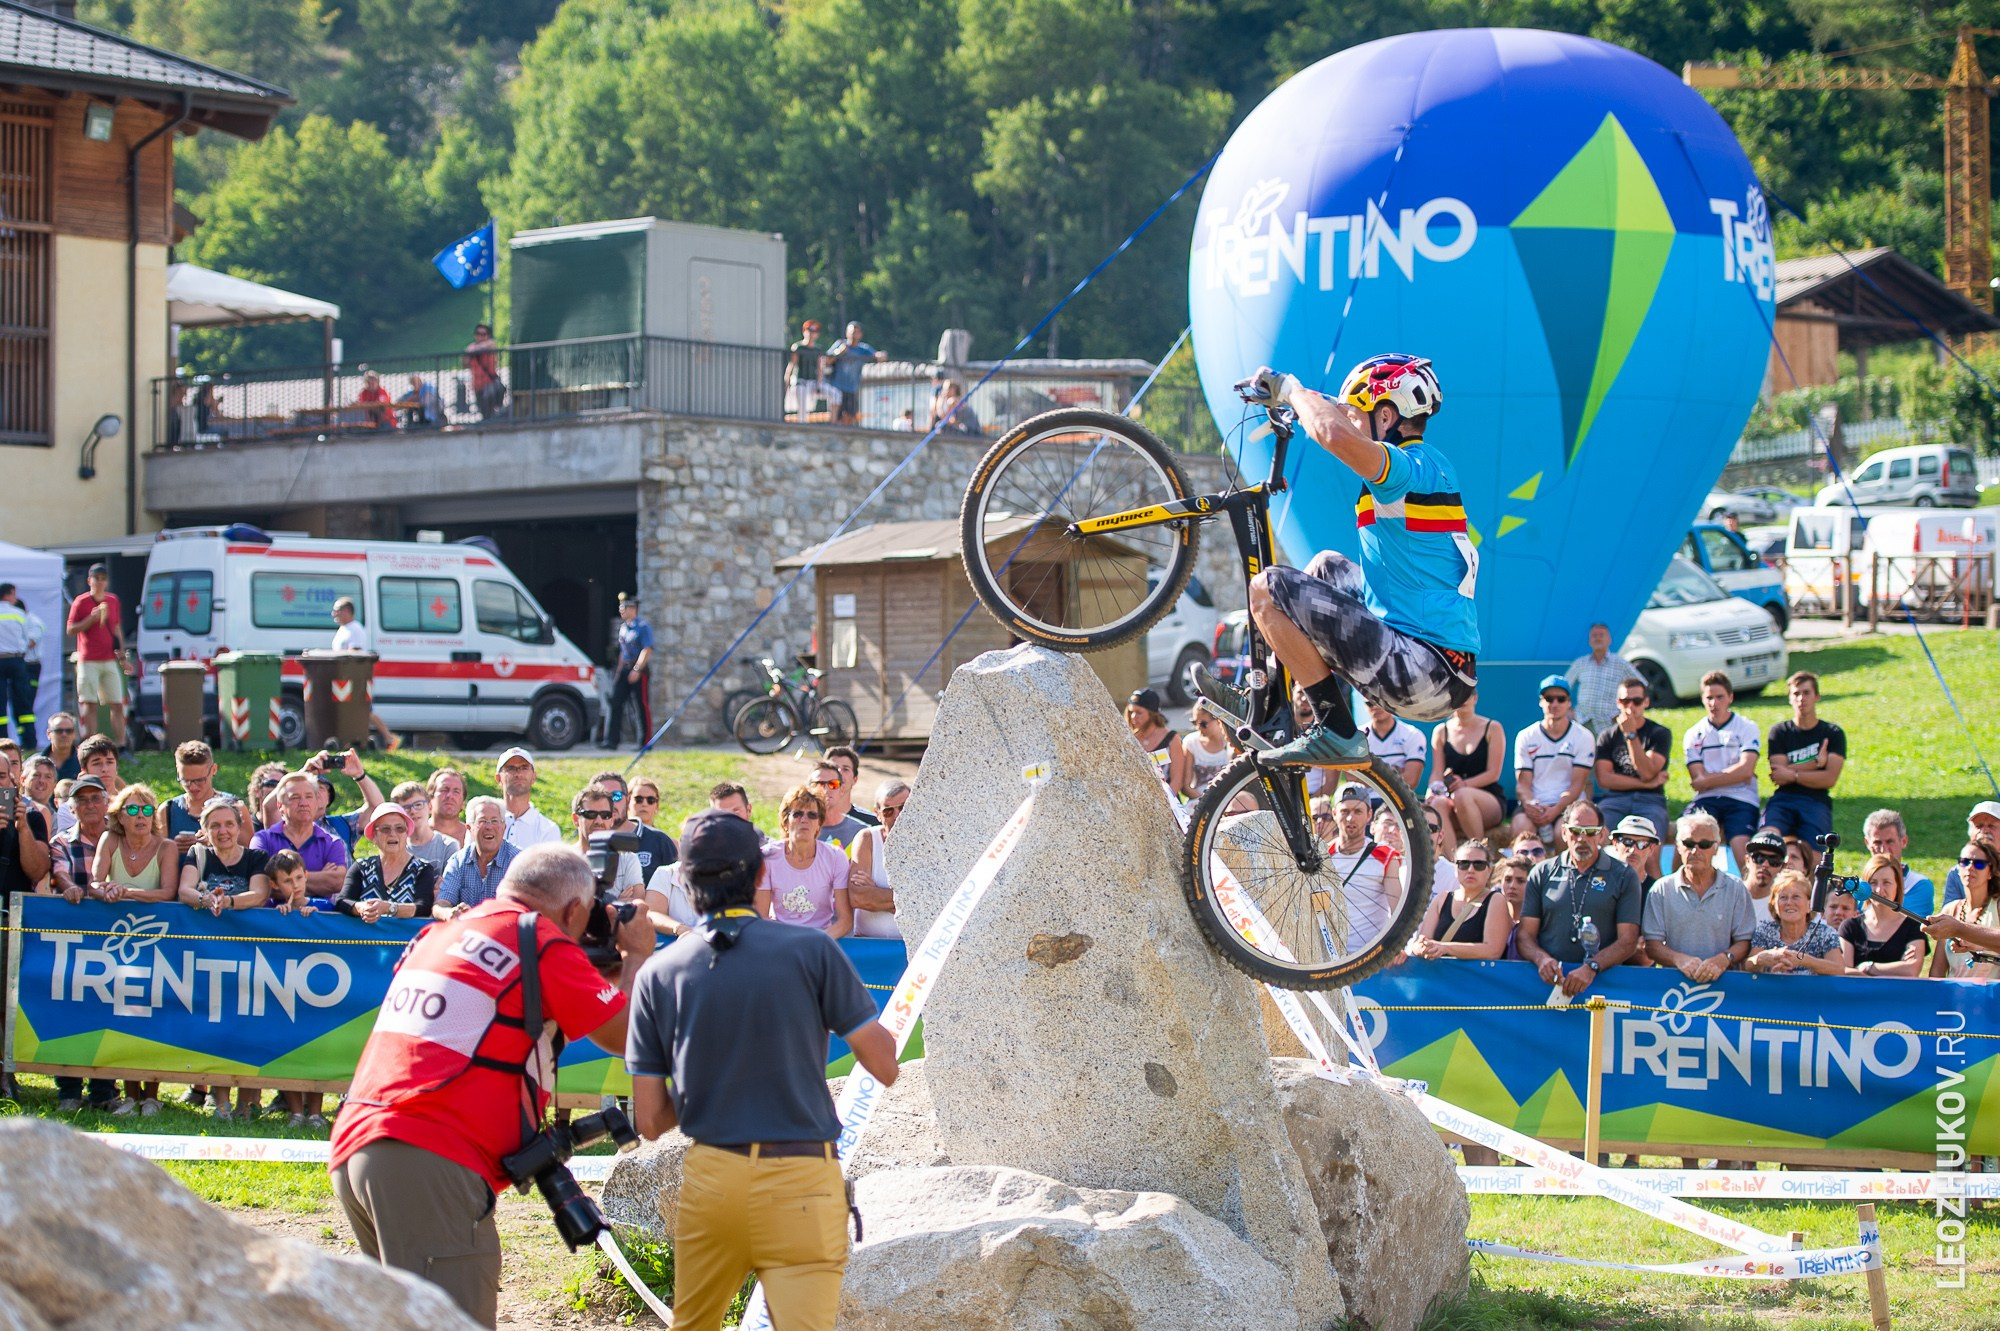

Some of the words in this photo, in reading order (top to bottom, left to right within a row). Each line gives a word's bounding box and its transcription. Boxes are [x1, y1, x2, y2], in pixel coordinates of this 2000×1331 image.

[1205, 196, 1478, 298] TRENTINO
[1096, 509, 1154, 527] mybike
[1192, 815, 1207, 866] KAISER
[923, 879, 977, 961] TRENTINO
[40, 932, 352, 1024] TRENTINO
[462, 937, 512, 974] UCI
[1309, 945, 1383, 980] CONTINENTAL
[1600, 1000, 1922, 1095] TRENTINO
[1794, 1249, 1873, 1276] TRENTINO
